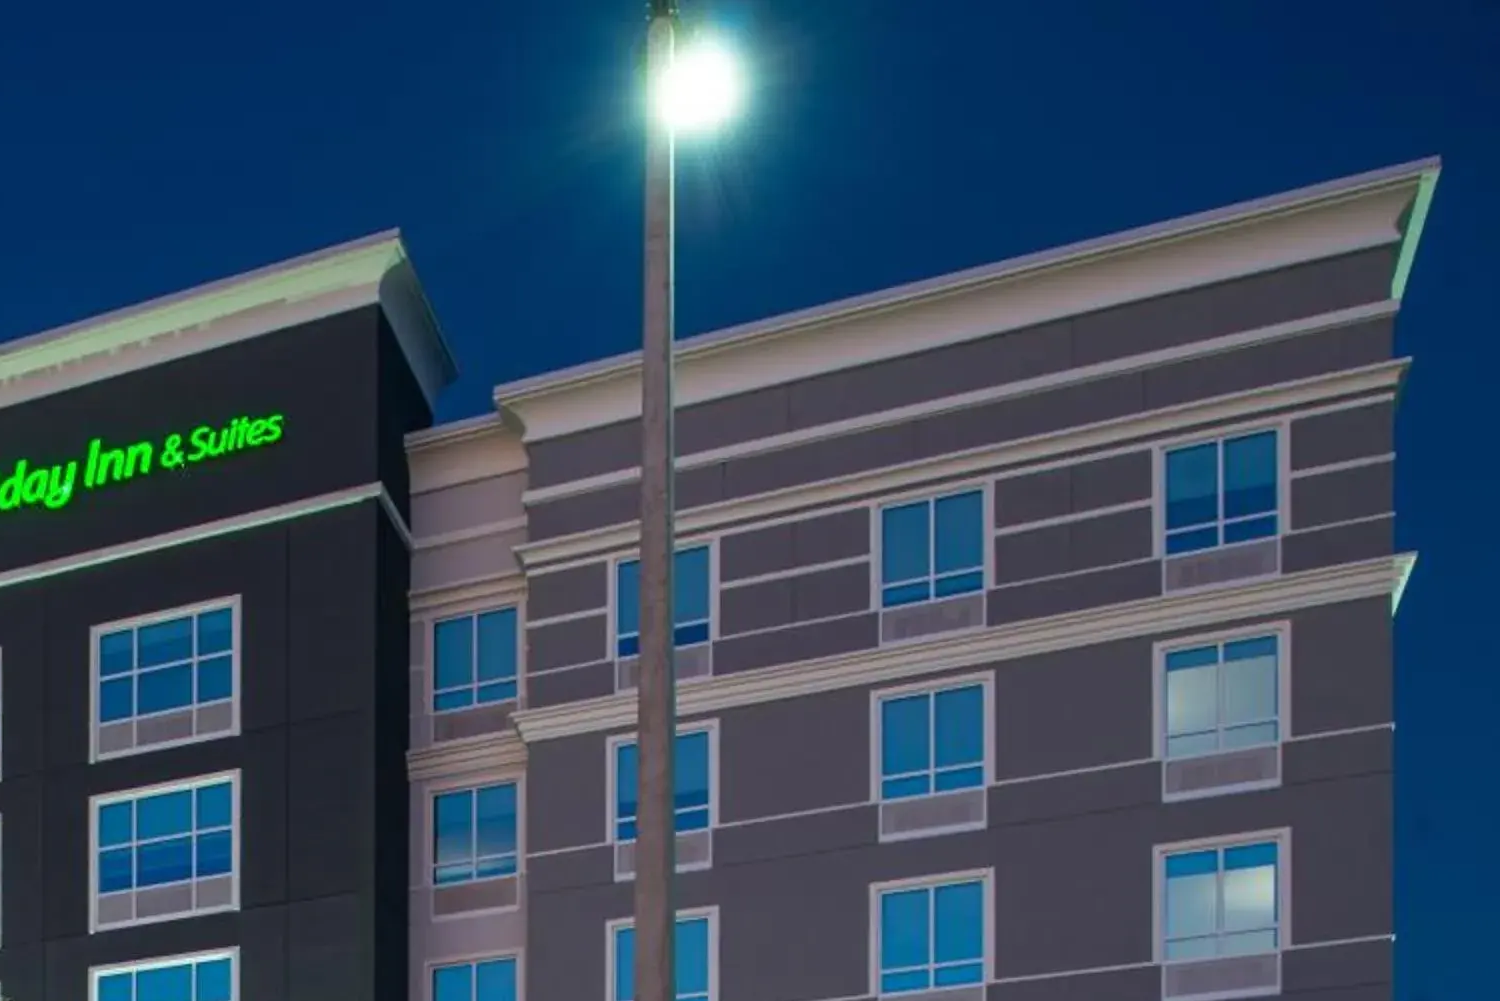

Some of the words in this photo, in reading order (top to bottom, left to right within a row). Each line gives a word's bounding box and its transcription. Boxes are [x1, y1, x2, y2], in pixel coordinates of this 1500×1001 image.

[84, 439, 152, 488] Inn
[160, 433, 185, 467] &
[188, 413, 284, 461] Suites
